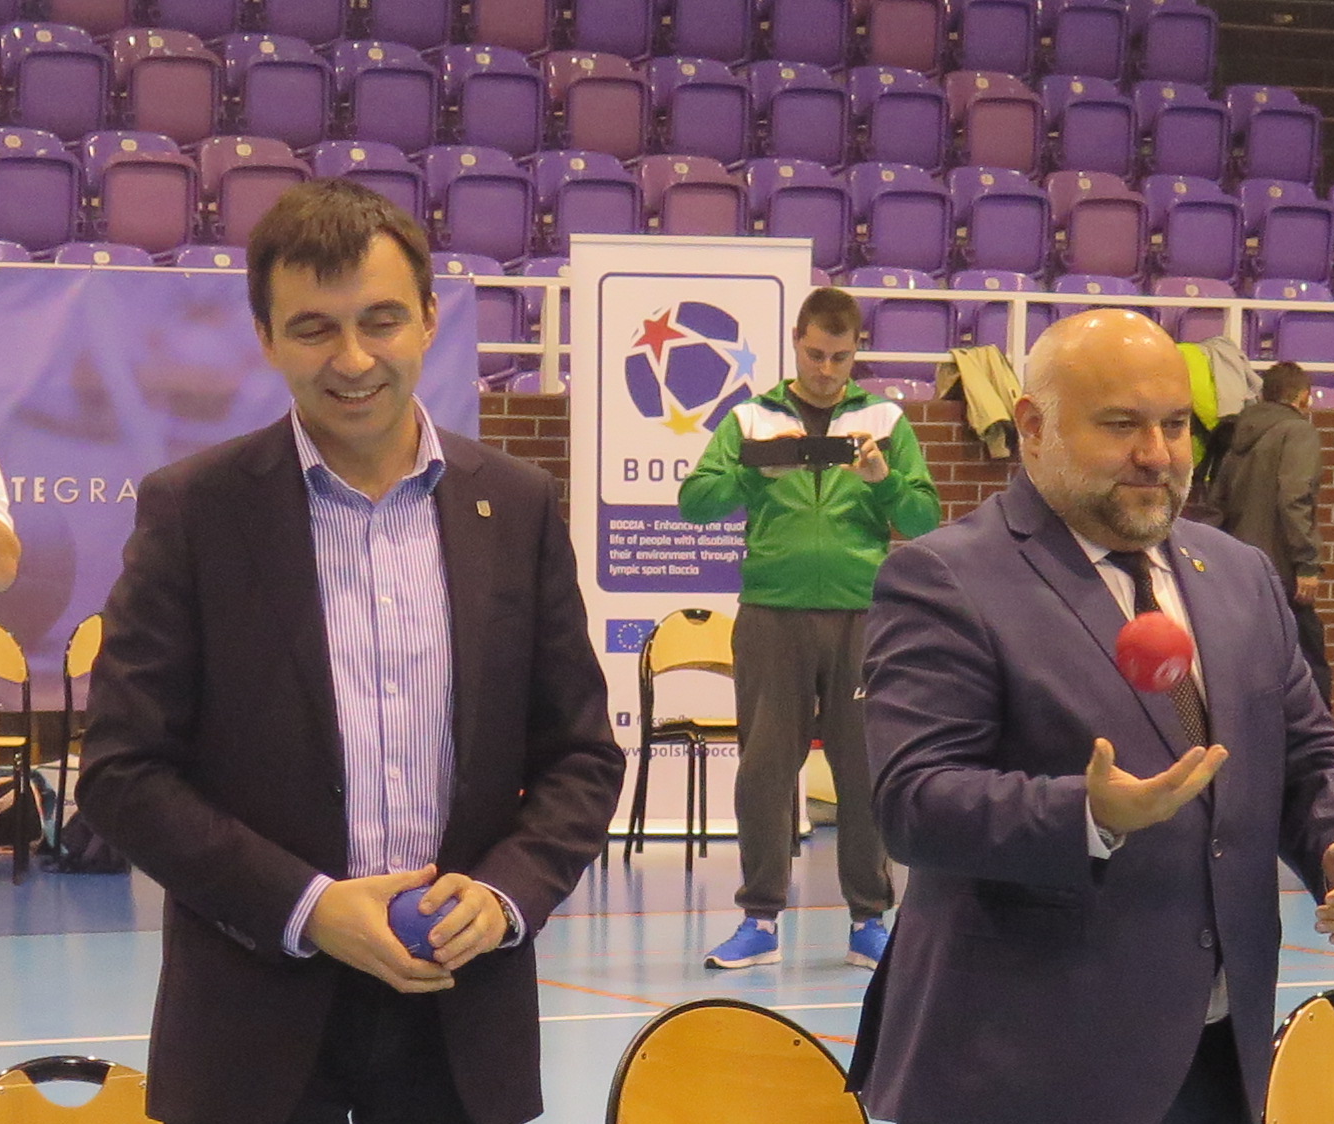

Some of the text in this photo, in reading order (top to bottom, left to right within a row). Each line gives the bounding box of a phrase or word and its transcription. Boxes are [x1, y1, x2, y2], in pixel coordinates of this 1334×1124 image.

[639, 534, 672, 546] people
[673, 534, 696, 546] with
[635, 549, 696, 560] environment
[700, 550, 739, 562] through
[641, 565, 667, 576] sport
[668, 564, 700, 575] Boccia
